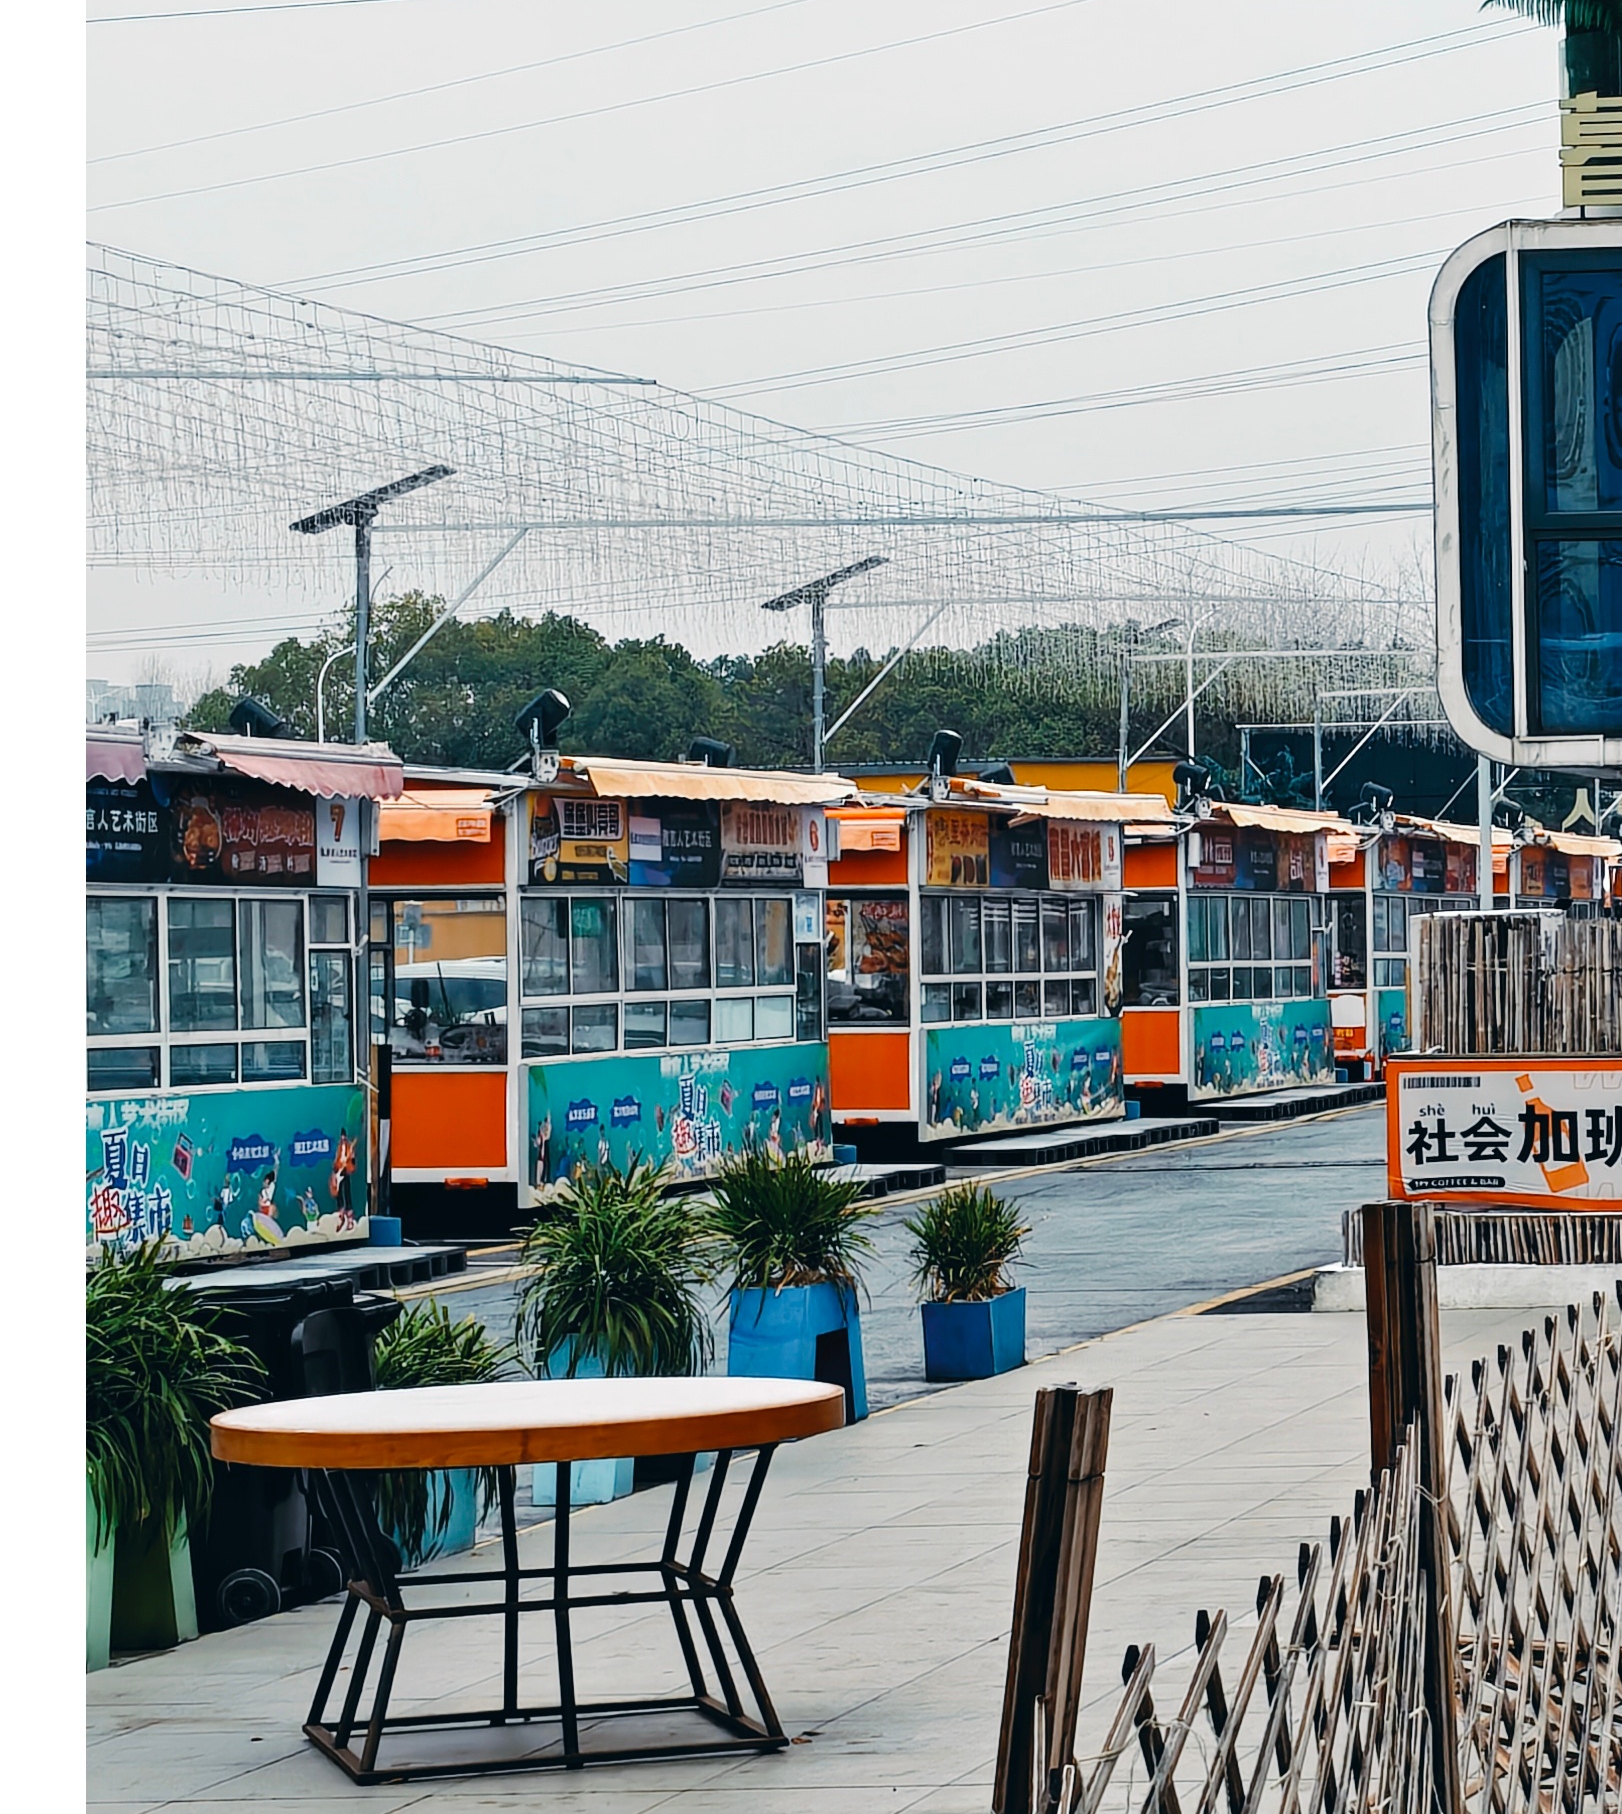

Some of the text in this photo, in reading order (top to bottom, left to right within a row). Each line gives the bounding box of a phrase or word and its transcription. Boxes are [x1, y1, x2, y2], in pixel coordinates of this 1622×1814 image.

[330, 803, 345, 842] 7
[1419, 1102, 1496, 1117] shè huì
